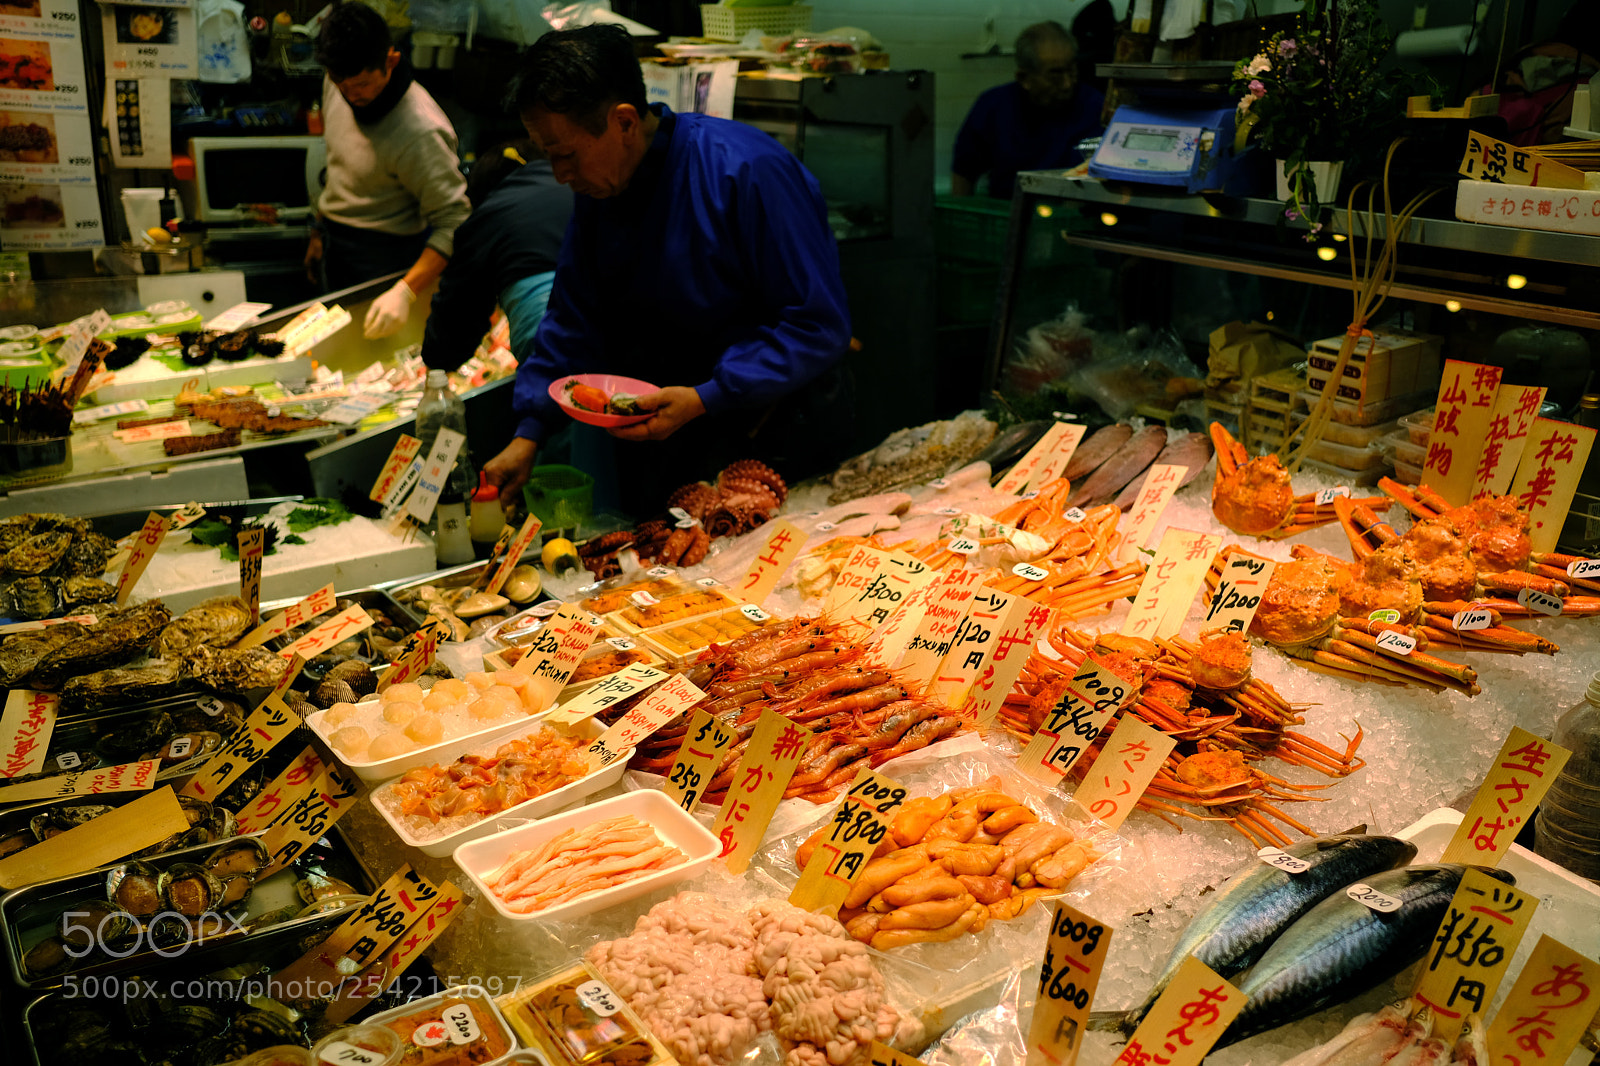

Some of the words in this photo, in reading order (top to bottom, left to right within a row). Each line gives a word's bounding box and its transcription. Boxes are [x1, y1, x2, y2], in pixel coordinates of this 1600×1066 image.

[849, 551, 880, 571] BIG
[837, 572, 869, 591] SIZE
[859, 573, 902, 602] ¥300
[943, 569, 979, 586] EAT
[939, 588, 972, 601] NOW
[1207, 582, 1260, 621] ¥1200
[925, 604, 960, 621] SASHIMI
[1378, 634, 1412, 649] 12000
[963, 651, 984, 670] 円
[661, 679, 697, 705] Bloody
[1072, 671, 1124, 712] 100g
[262, 705, 289, 726] 一ツ
[670, 762, 701, 790] 250
[848, 776, 907, 814] 100g
[1467, 740, 1552, 852] 生さば
[830, 801, 887, 845] ¥800
[1350, 886, 1394, 909] 2000
[1465, 888, 1523, 913] 一ツ
[1051, 908, 1103, 955] 100g
[1429, 908, 1505, 971] ¥550
[451, 1012, 471, 1039] 2200
